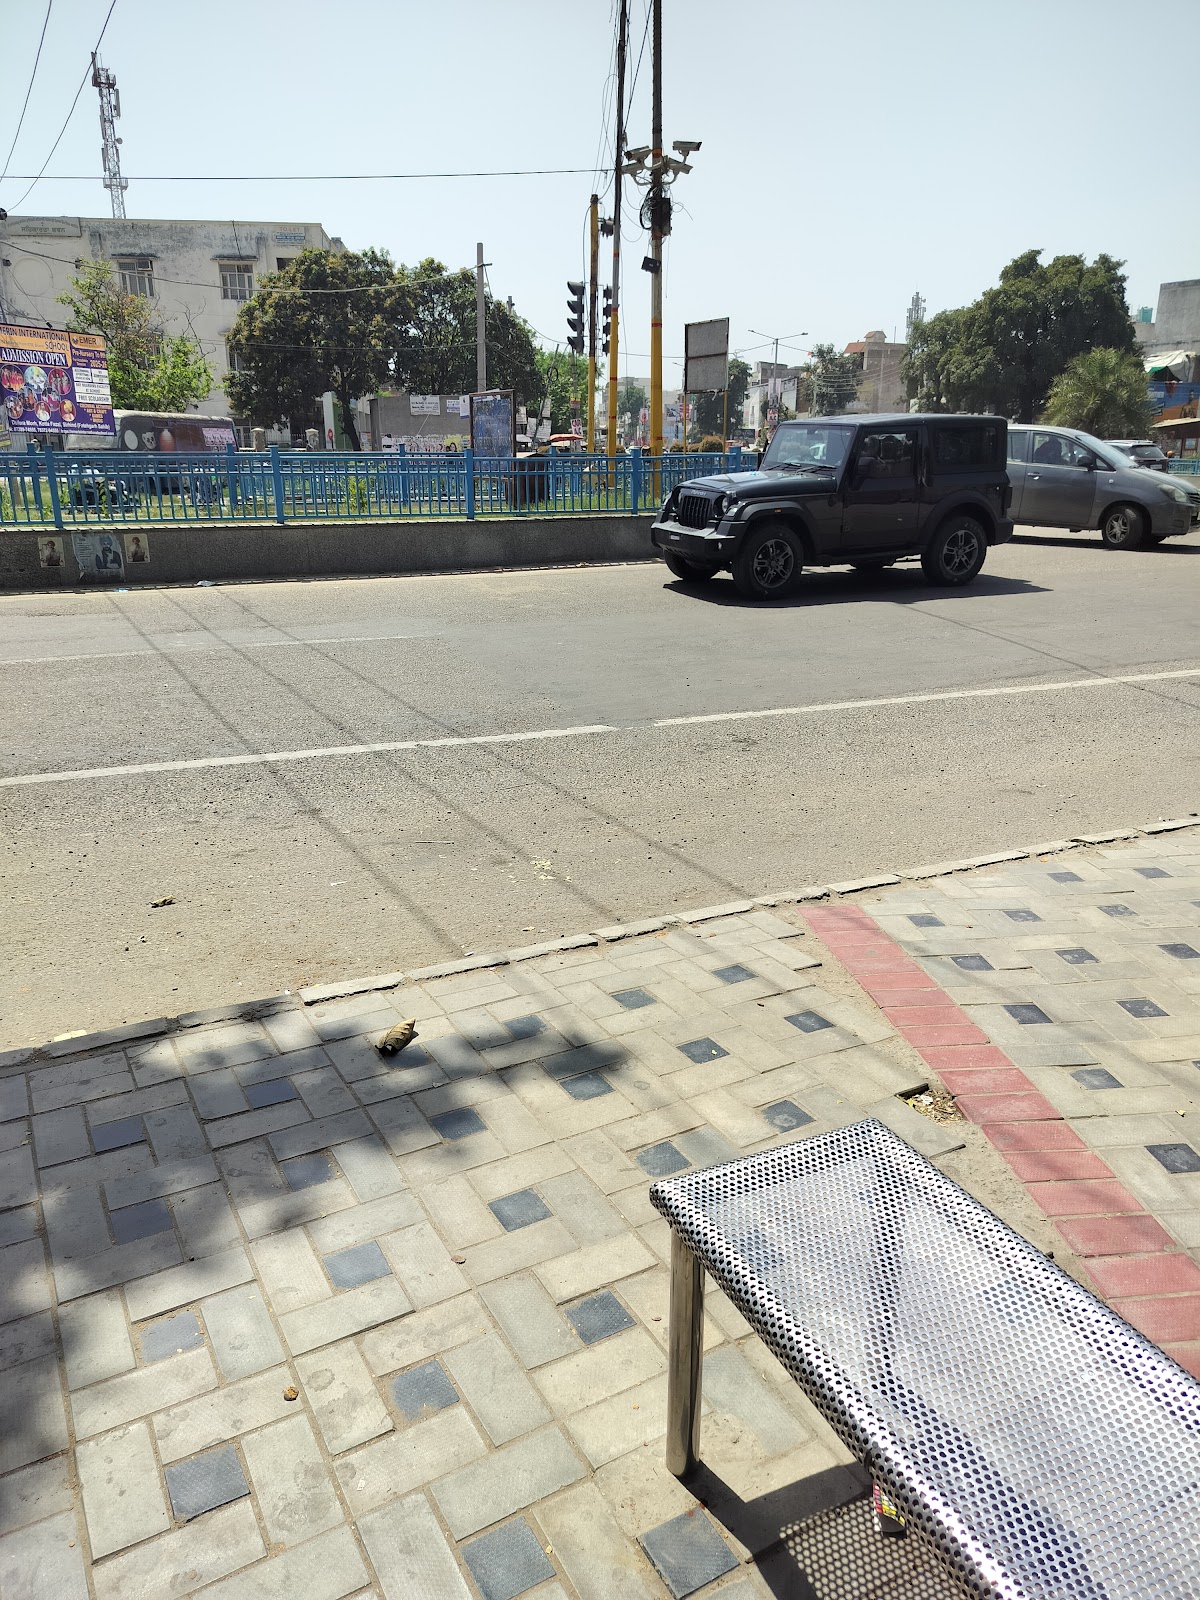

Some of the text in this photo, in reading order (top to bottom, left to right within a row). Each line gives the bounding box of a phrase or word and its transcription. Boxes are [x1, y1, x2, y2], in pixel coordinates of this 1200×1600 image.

[19, 329, 68, 342] INTERNATIONAL
[45, 341, 69, 351] SCHOOL
[2, 348, 44, 363] ADMISSION
[45, 352, 66, 366] OPEN
